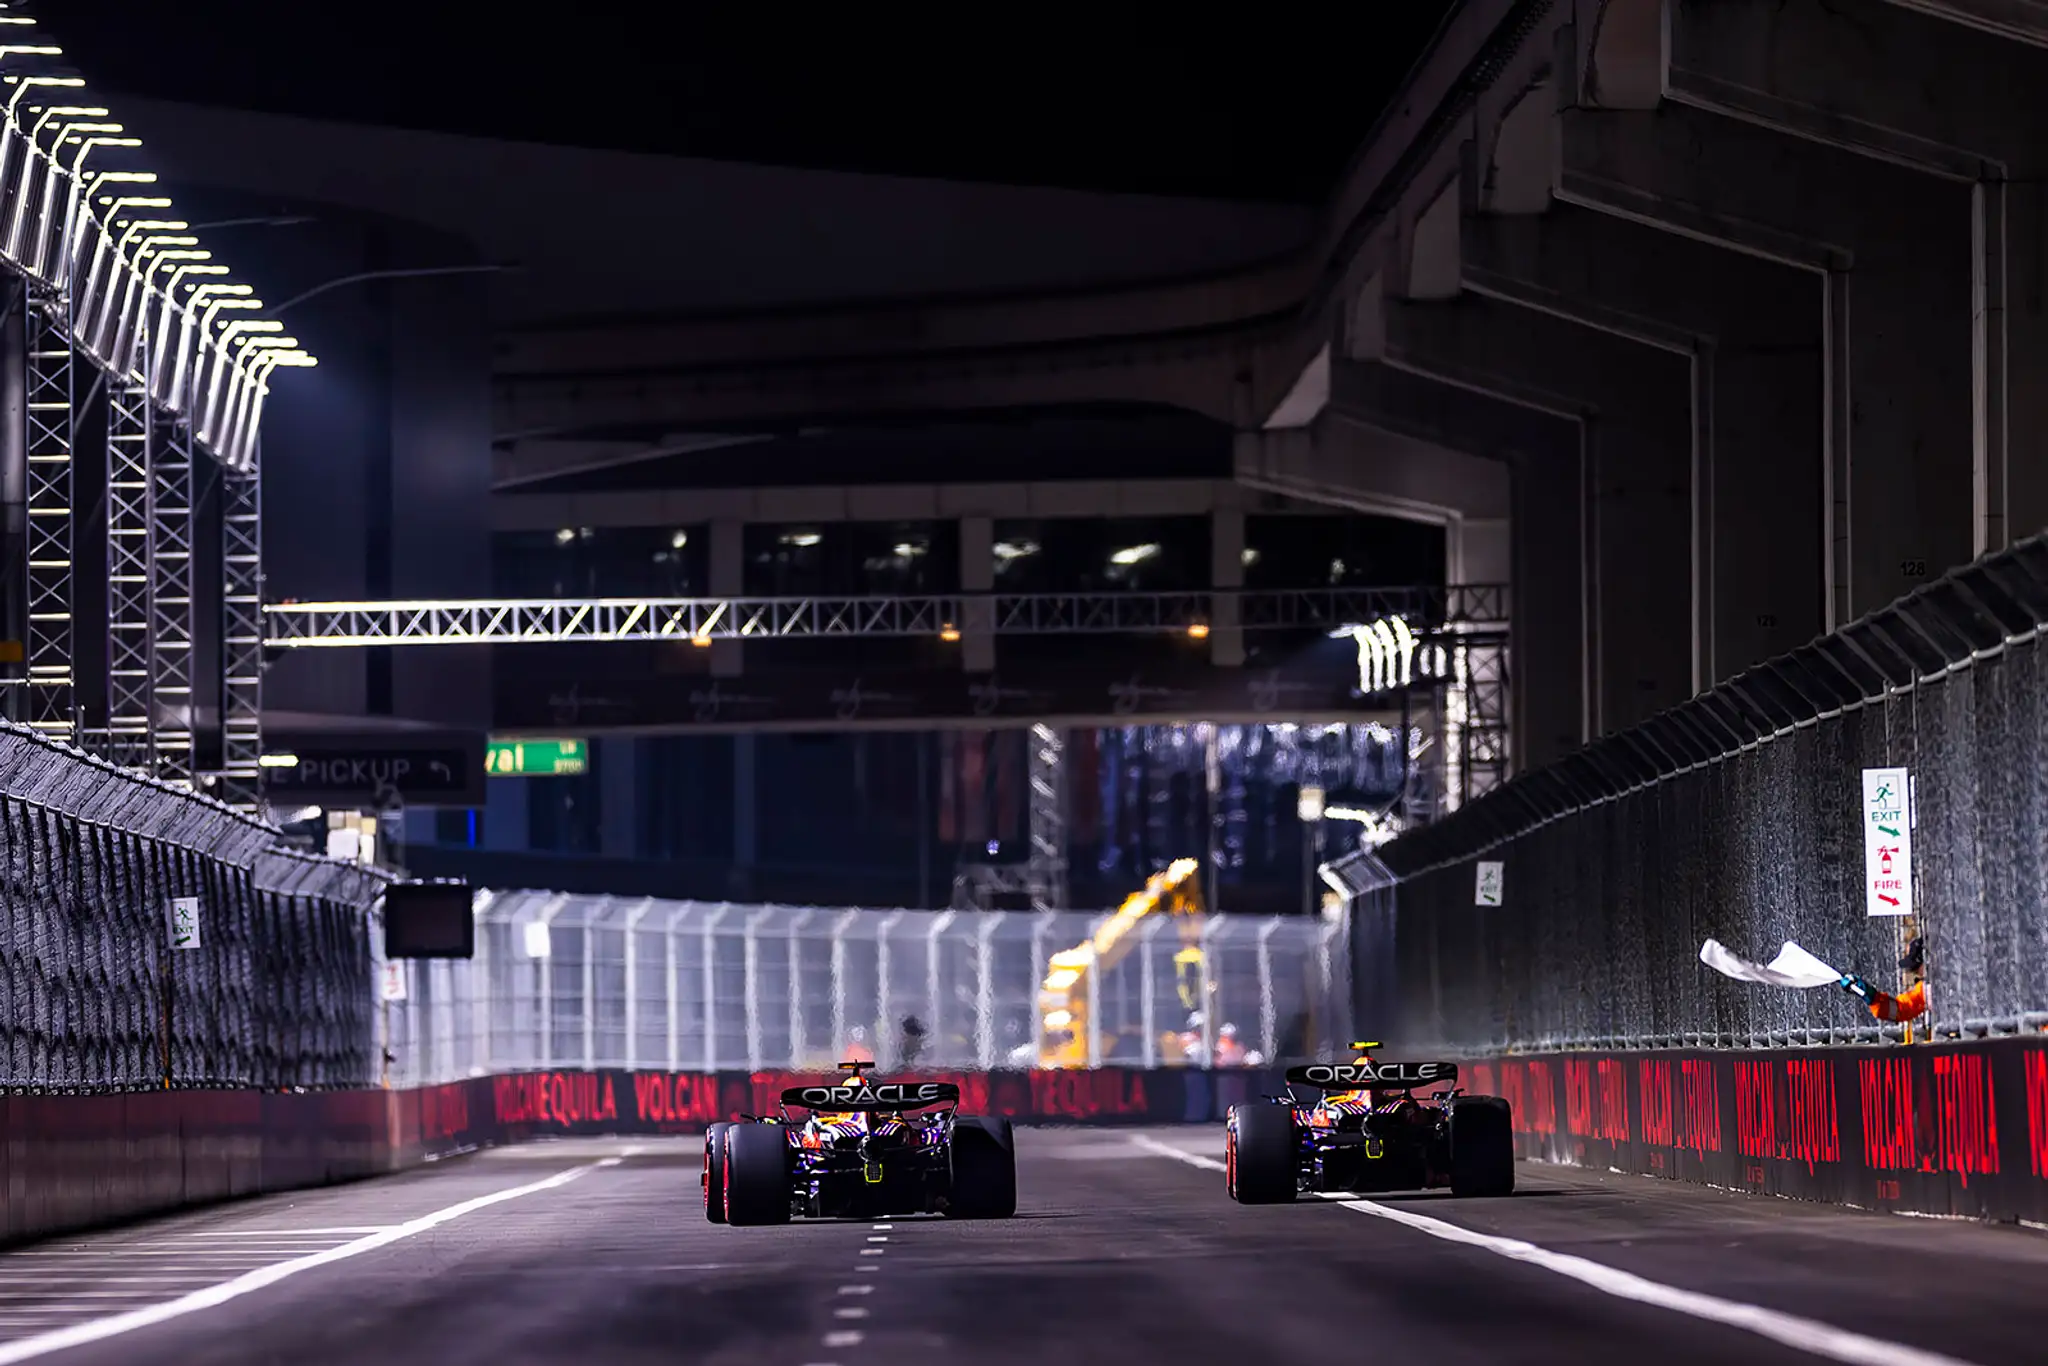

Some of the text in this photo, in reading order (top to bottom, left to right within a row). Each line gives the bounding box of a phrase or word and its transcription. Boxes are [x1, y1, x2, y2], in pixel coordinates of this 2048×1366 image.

[1900, 561, 1926, 577] 128
[301, 757, 410, 785] PICKUP
[1871, 810, 1902, 822] EXIT
[1873, 879, 1902, 890] FIRE
[1306, 1063, 1438, 1082] ORACLE
[634, 1073, 719, 1122] VOLCAN
[801, 1083, 939, 1106] ORACLE
[1734, 1058, 1841, 1177] VOLCAN TEQUILA
[1859, 1053, 2001, 1189] VOLCAN TEQUILA
